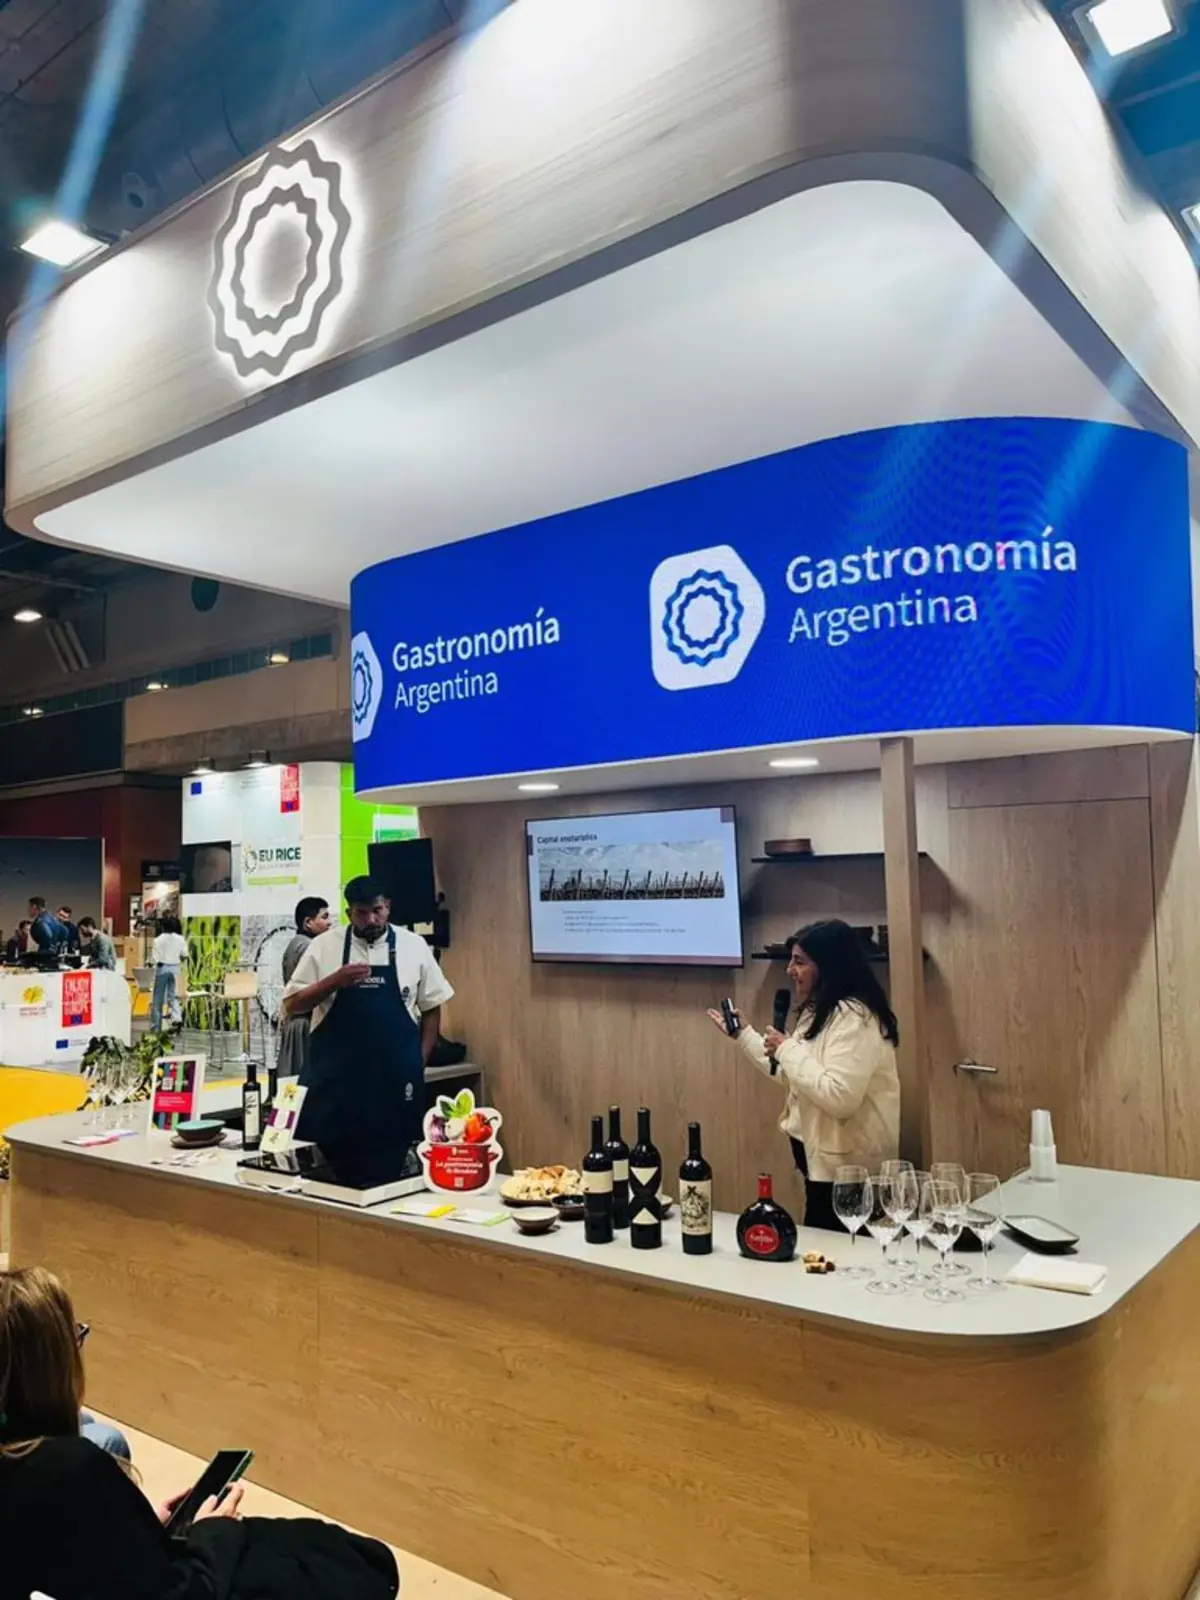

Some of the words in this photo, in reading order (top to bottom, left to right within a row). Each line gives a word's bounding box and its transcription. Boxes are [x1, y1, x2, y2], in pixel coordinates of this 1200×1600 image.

[786, 525, 1078, 594] Gastronomía
[391, 607, 562, 672] Gastronomía
[789, 590, 978, 648] Argentina
[394, 669, 499, 714] Argentina
[259, 849, 273, 862] EU
[276, 847, 301, 861] RICE
